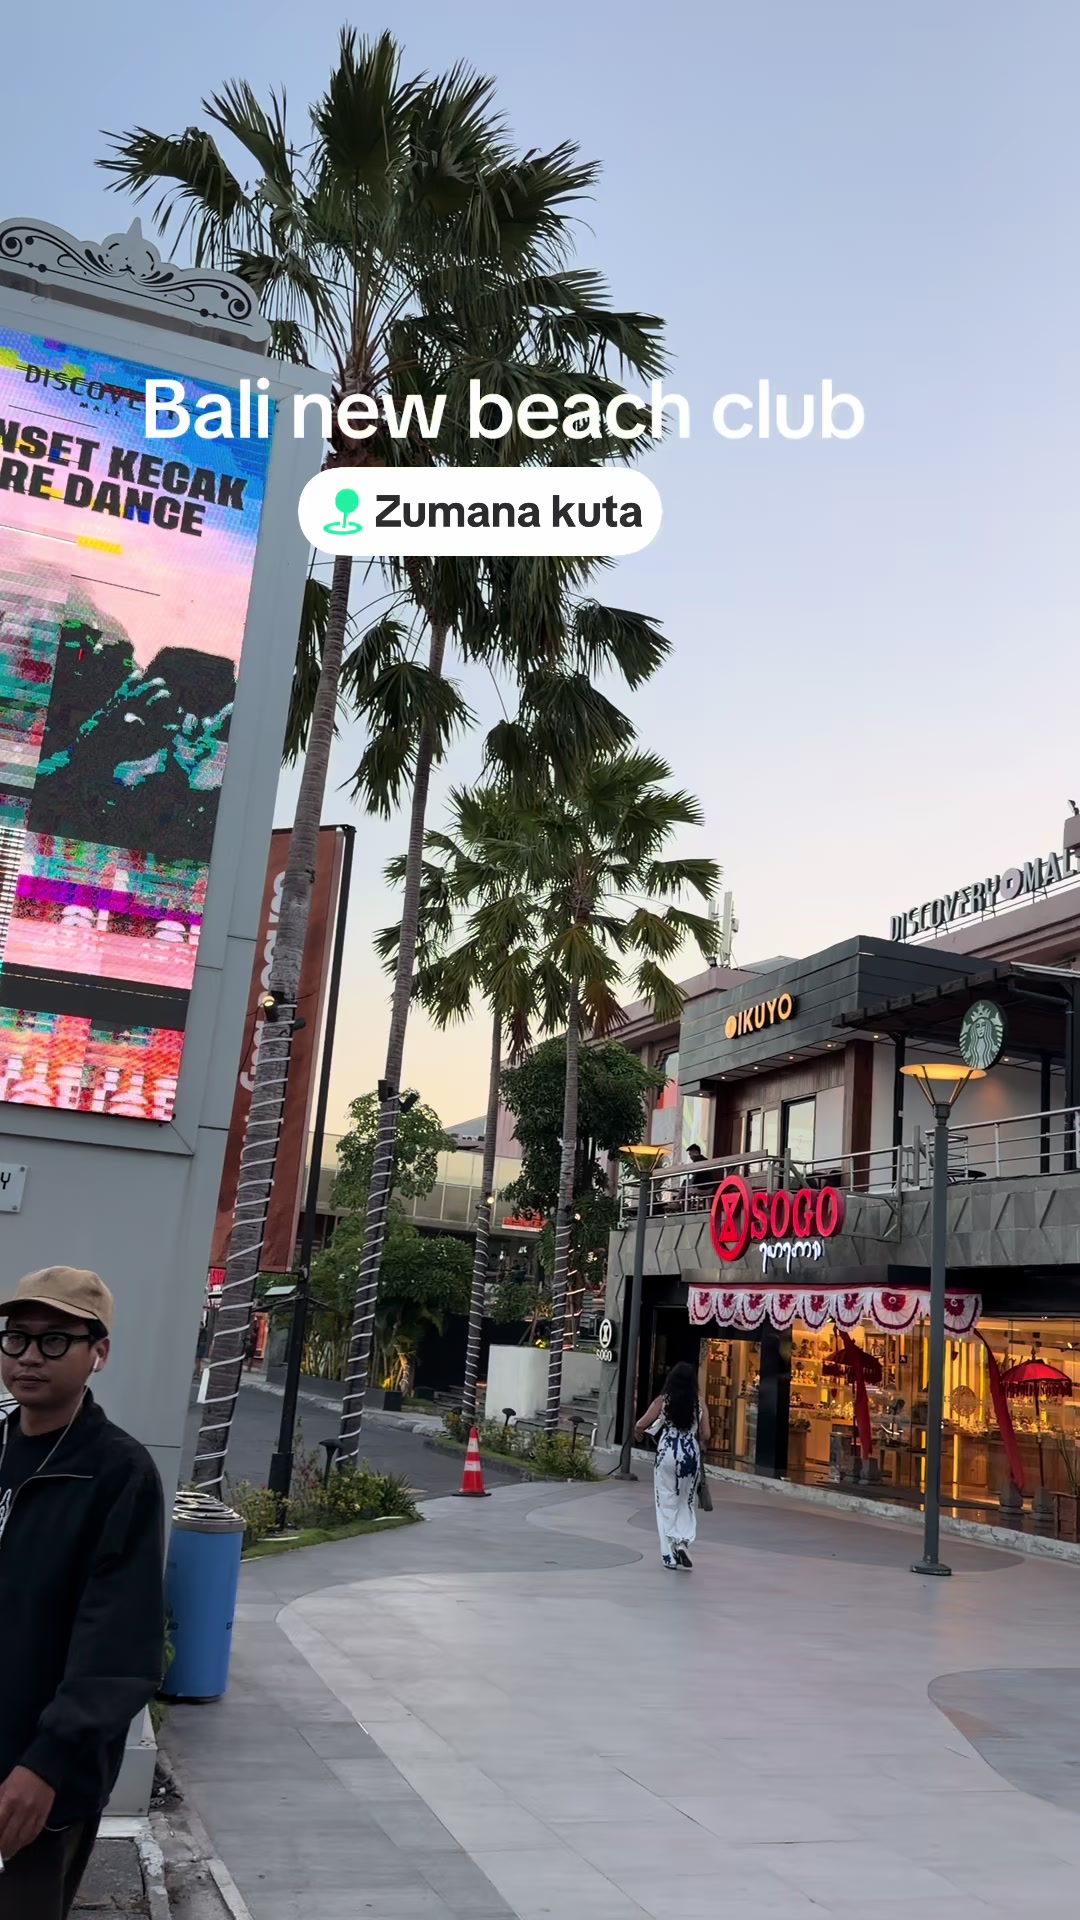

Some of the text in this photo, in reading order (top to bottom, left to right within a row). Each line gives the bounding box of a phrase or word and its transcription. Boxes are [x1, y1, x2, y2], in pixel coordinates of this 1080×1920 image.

[79, 401, 120, 417] MALL
[63, 473, 206, 537] DANCE
[107, 446, 248, 511] KECAK
[889, 874, 1001, 943] DISCOVERY
[751, 1186, 846, 1240] SOGO
